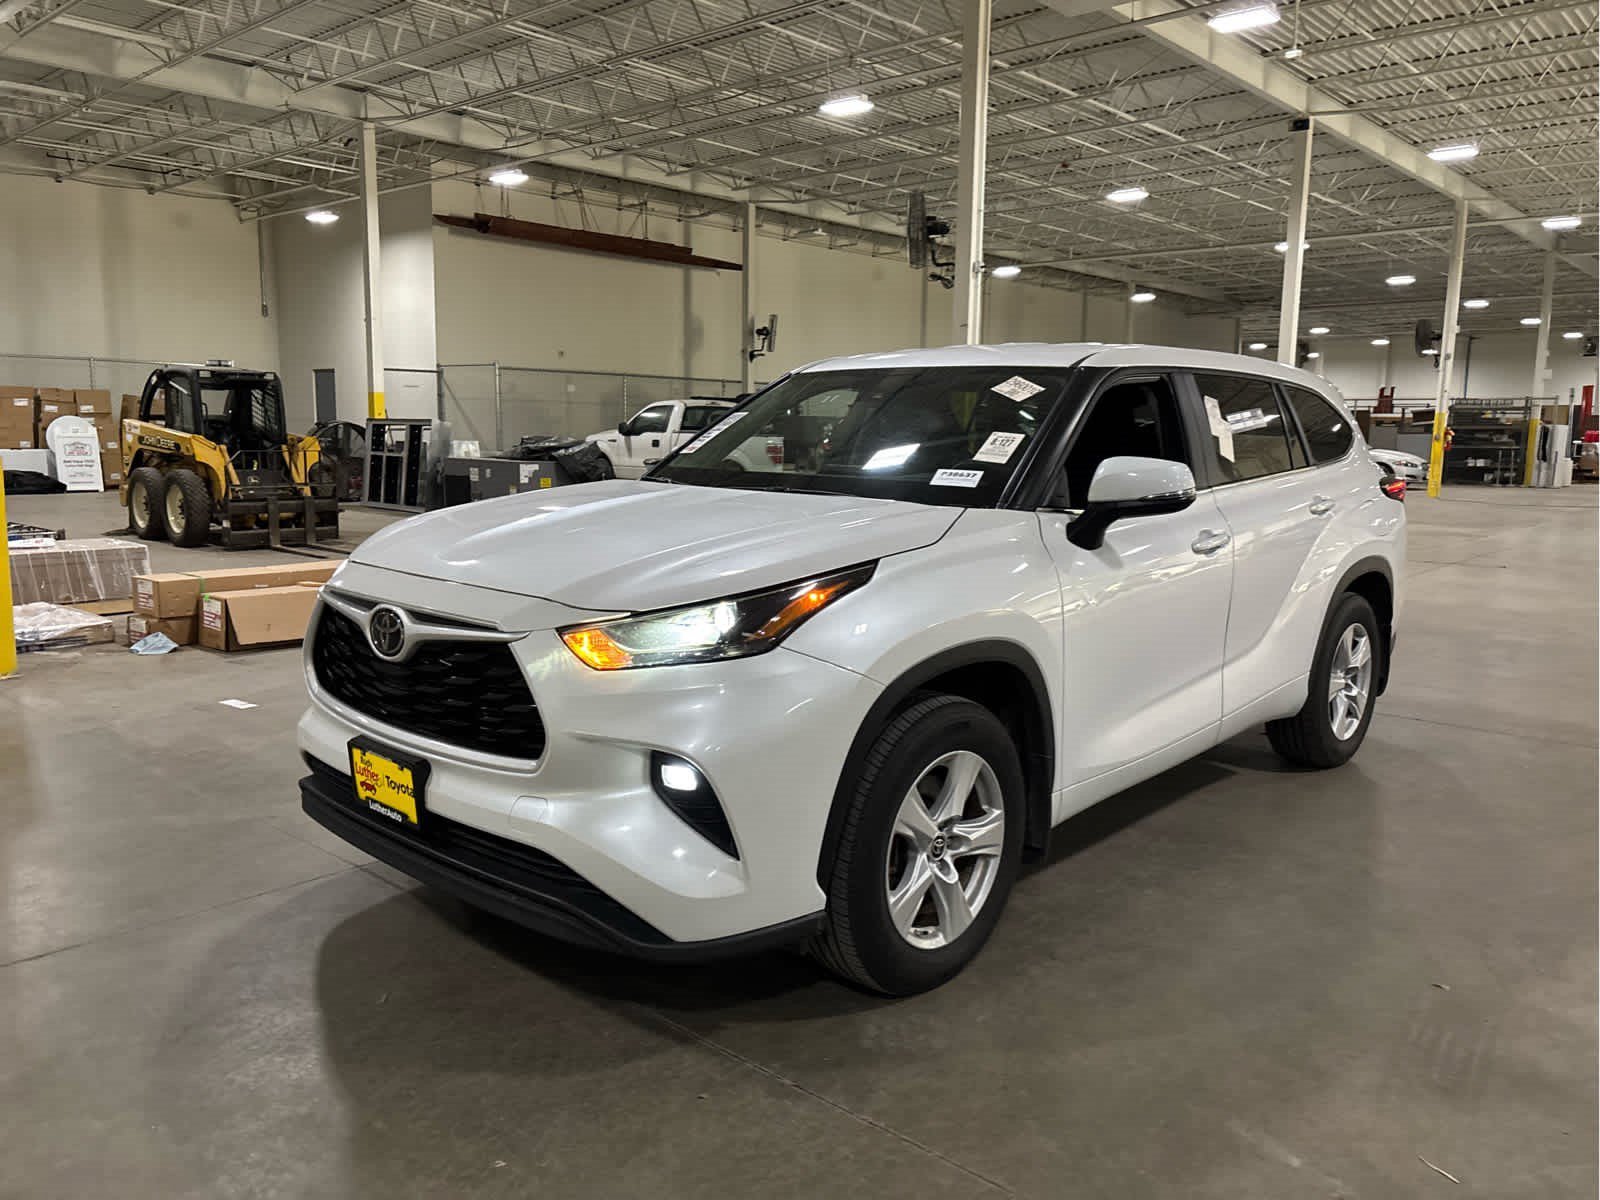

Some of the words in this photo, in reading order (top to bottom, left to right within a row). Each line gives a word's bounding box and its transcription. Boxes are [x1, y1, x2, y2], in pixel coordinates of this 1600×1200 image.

[156, 436, 176, 449] DEERE
[355, 762, 380, 781] Luther
[385, 775, 414, 796] Toyota
